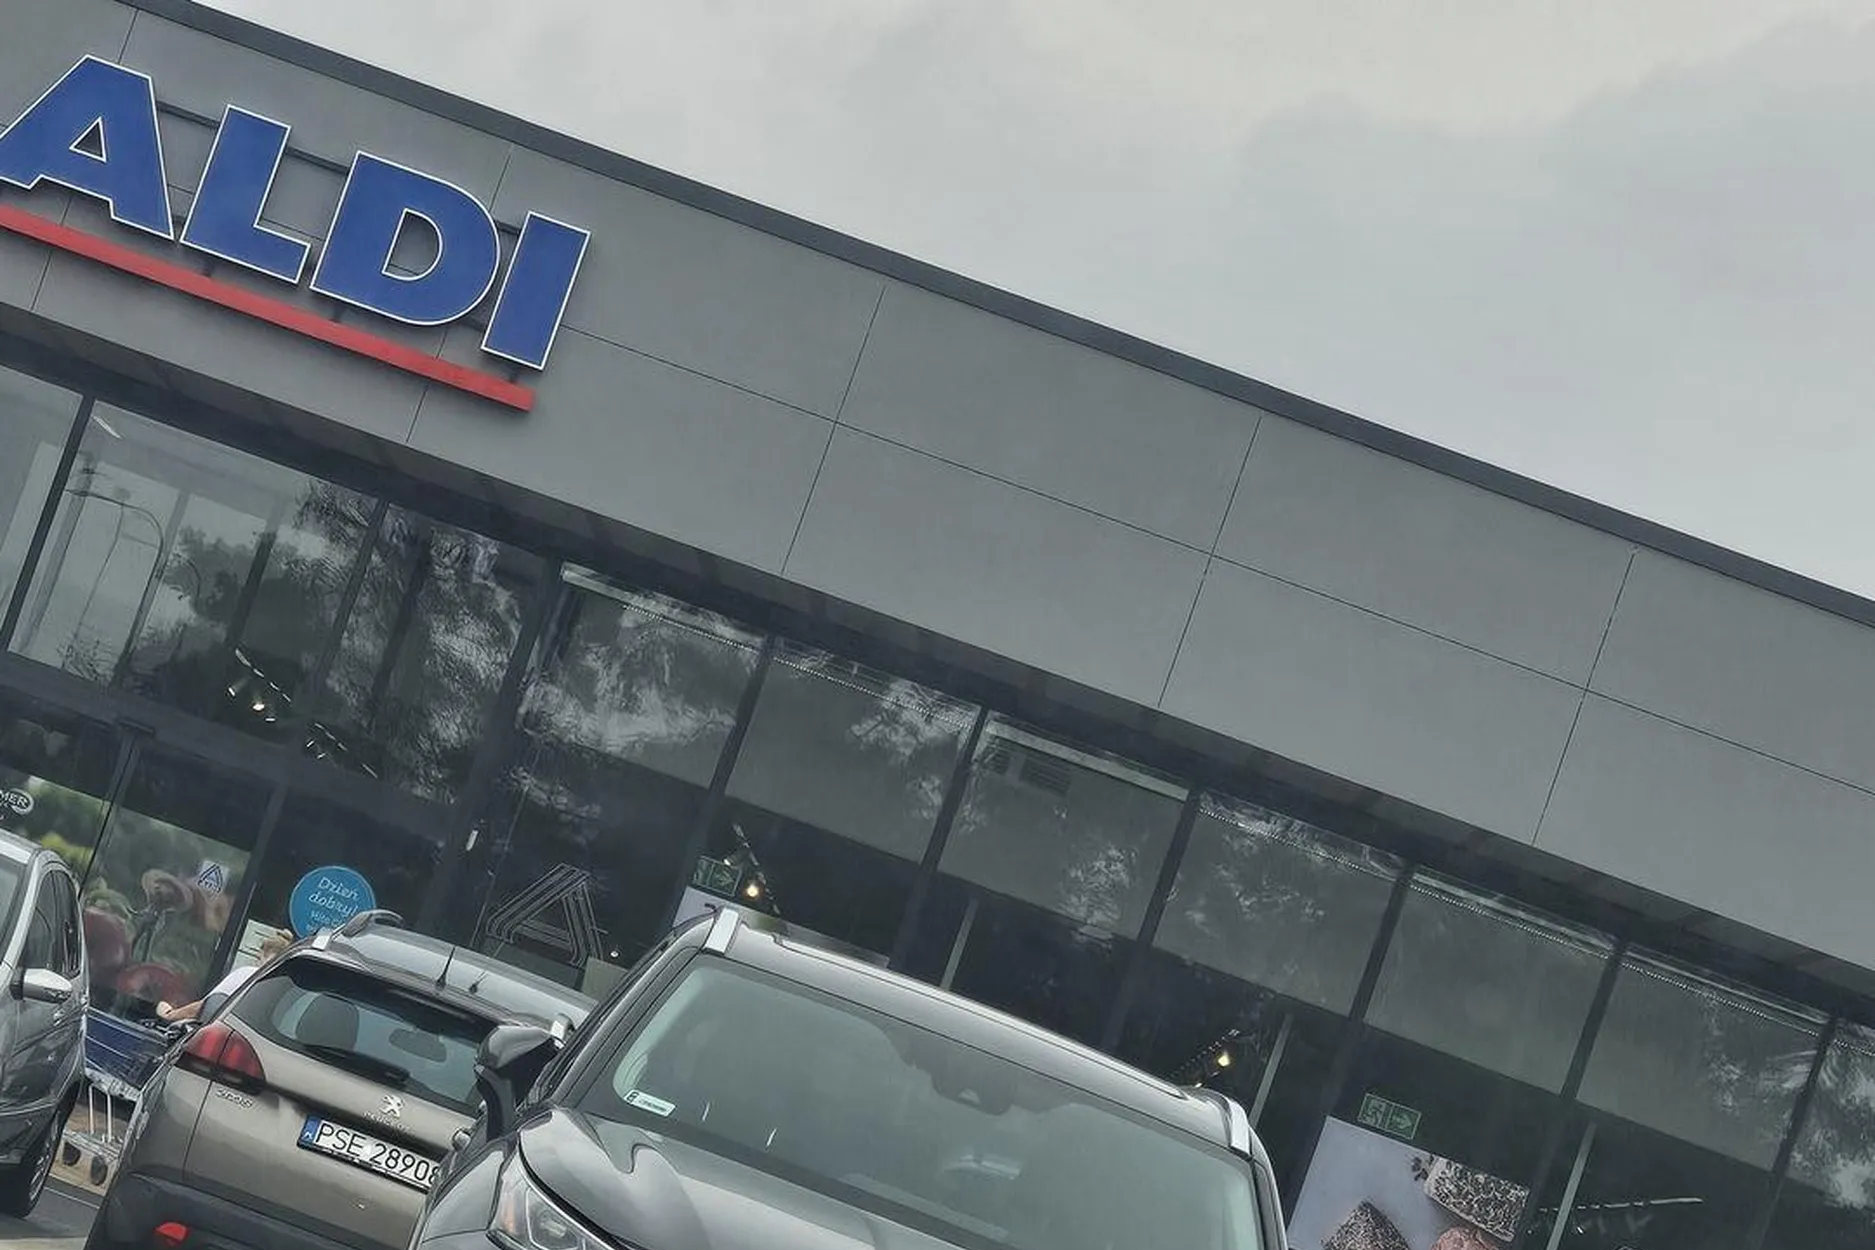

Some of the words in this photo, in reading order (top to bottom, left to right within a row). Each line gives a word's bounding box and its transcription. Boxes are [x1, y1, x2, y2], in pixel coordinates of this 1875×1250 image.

[0, 54, 591, 371] ALDI
[308, 891, 359, 918] dobry!
[315, 1123, 366, 1157] PSE
